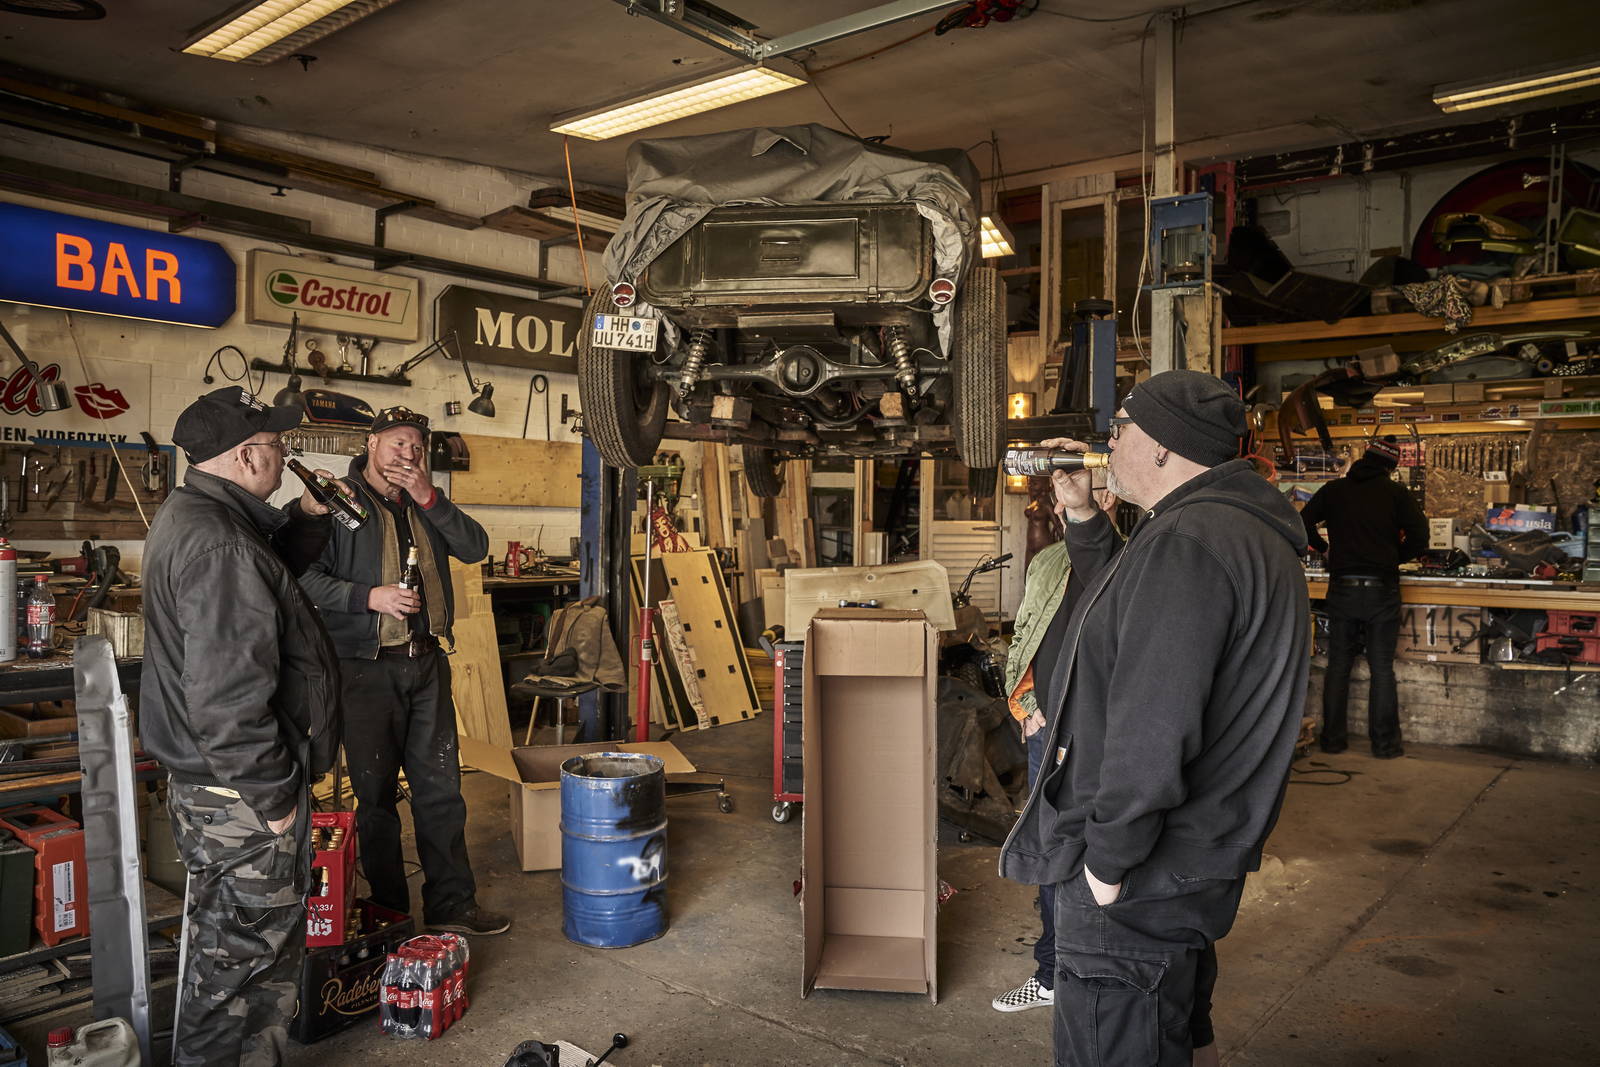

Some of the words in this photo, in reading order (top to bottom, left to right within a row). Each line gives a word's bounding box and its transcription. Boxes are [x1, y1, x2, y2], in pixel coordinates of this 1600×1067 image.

[56, 232, 182, 305] BAR
[300, 278, 392, 317] Castrol
[475, 307, 582, 357] MOL
[611, 317, 630, 332] HH
[617, 332, 654, 349] 741H
[312, 399, 337, 409] YAMAHA
